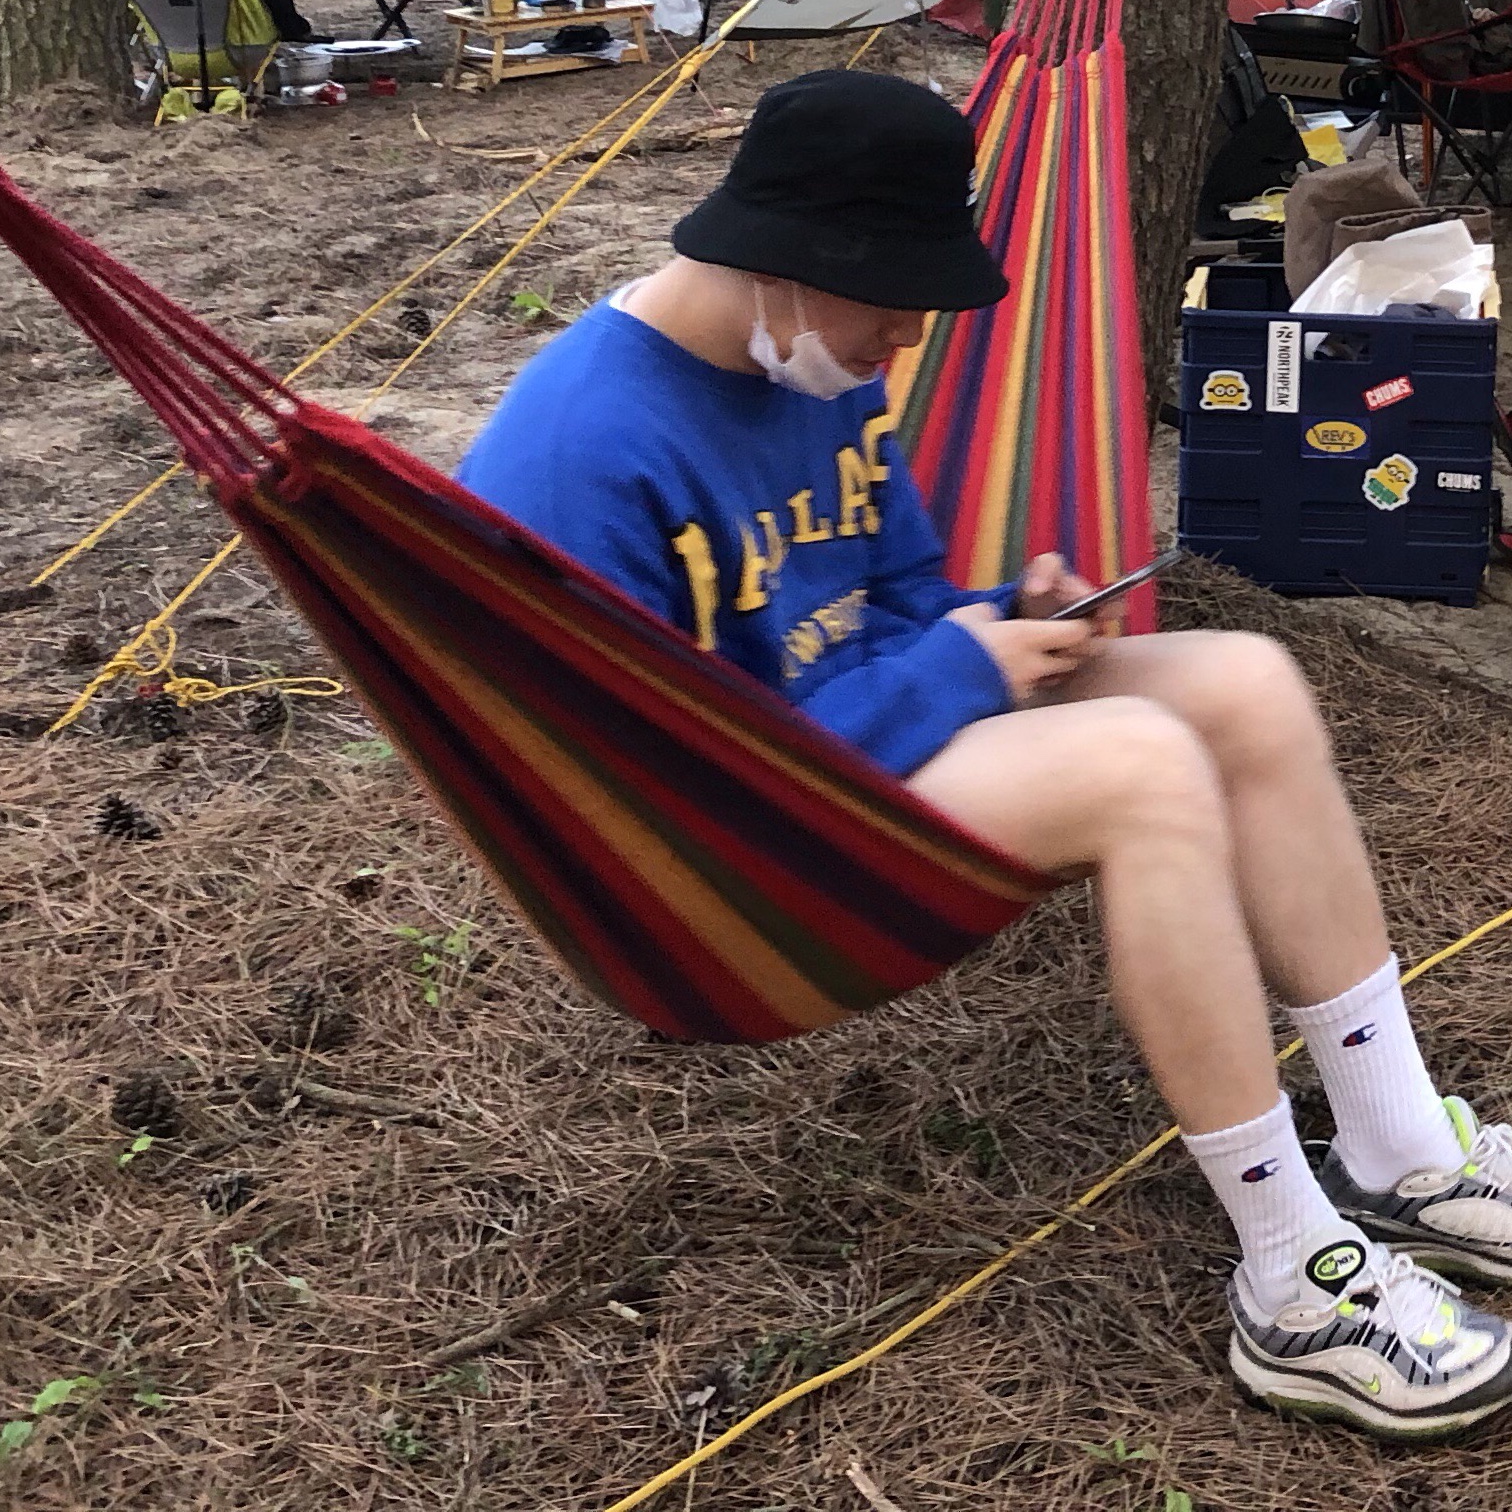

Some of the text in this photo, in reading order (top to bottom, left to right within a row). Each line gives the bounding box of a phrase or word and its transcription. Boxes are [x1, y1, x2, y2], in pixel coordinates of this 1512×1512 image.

[1276, 345, 1292, 407] NORTHPEAK
[1366, 377, 1412, 407] CHUMS
[1437, 471, 1482, 490] CHUMS
